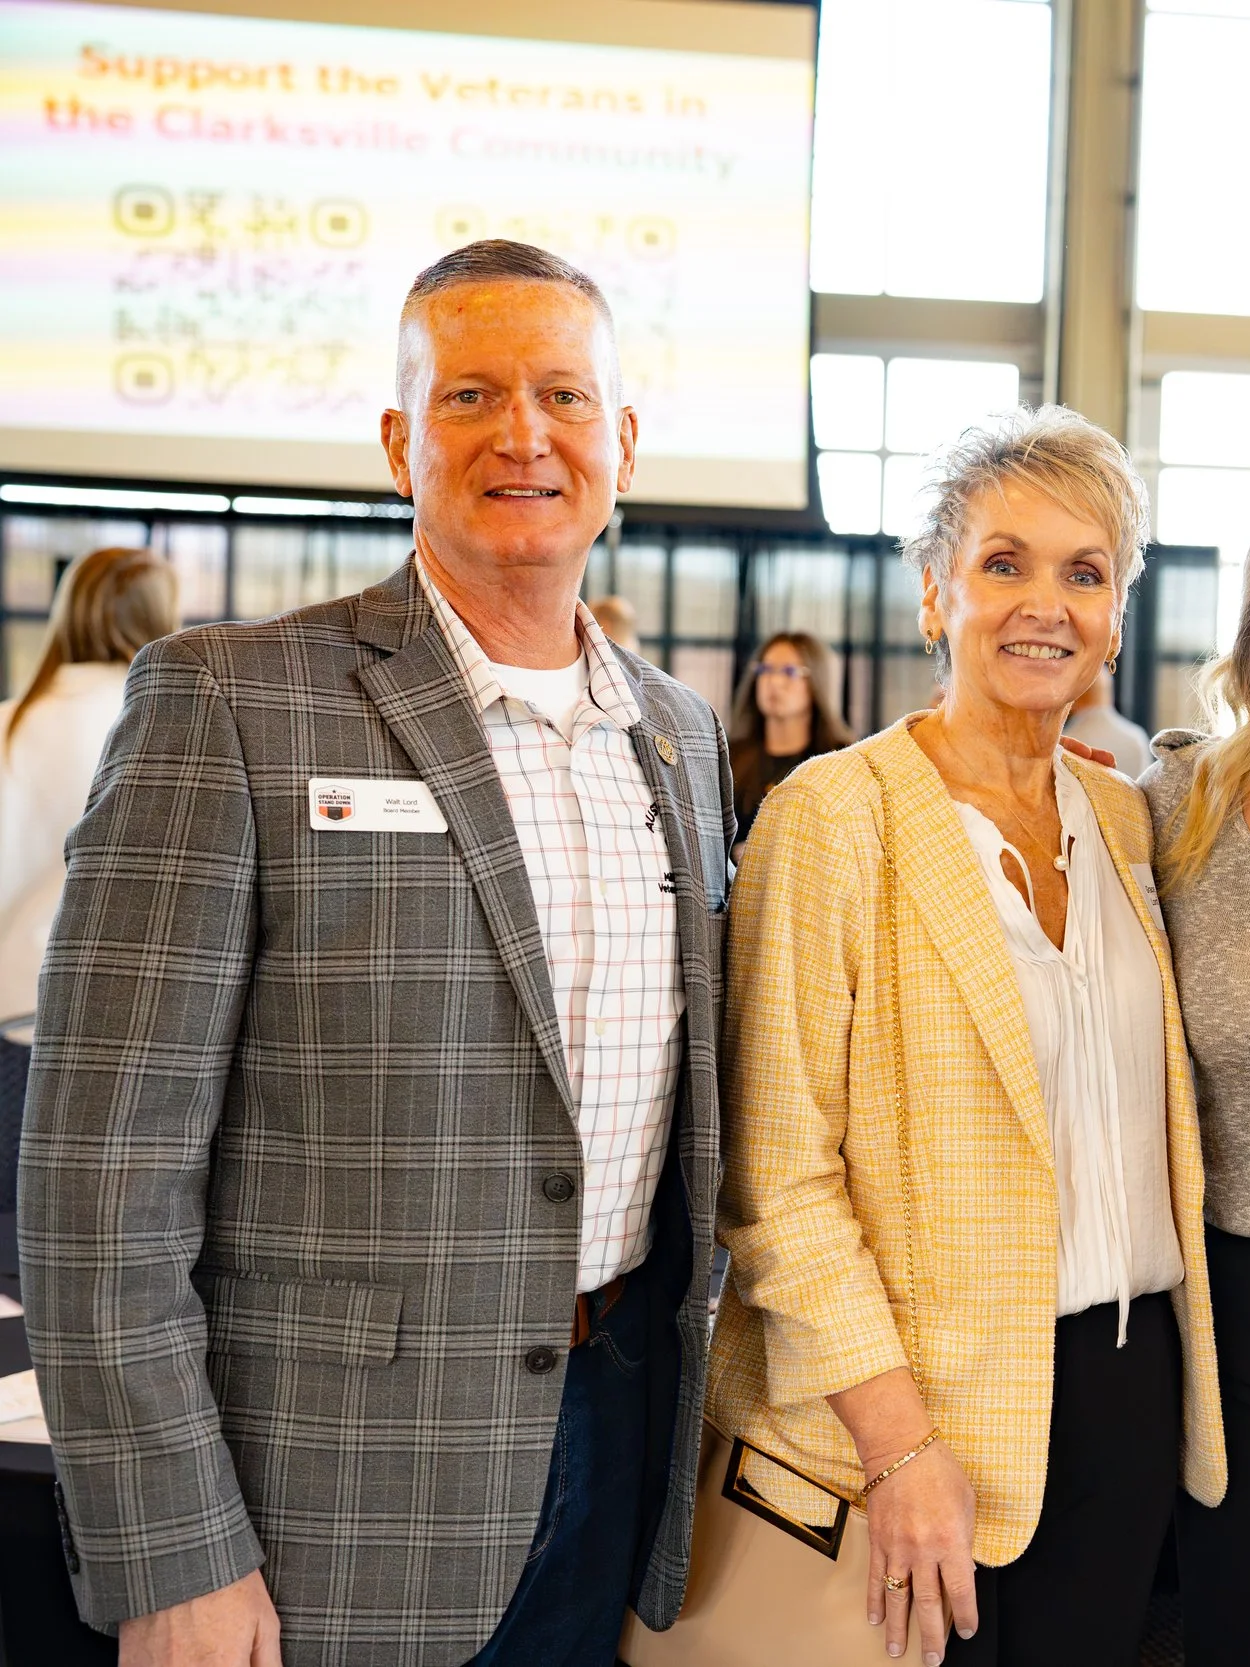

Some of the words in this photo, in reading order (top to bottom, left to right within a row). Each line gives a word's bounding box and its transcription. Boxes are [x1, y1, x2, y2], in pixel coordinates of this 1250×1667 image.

[76, 41, 296, 92] Support
[316, 63, 400, 97] the
[419, 71, 646, 116] Veterans
[662, 84, 708, 119] in
[41, 94, 134, 136] the
[152, 102, 428, 154] Clarksville
[450, 126, 740, 182] Community
